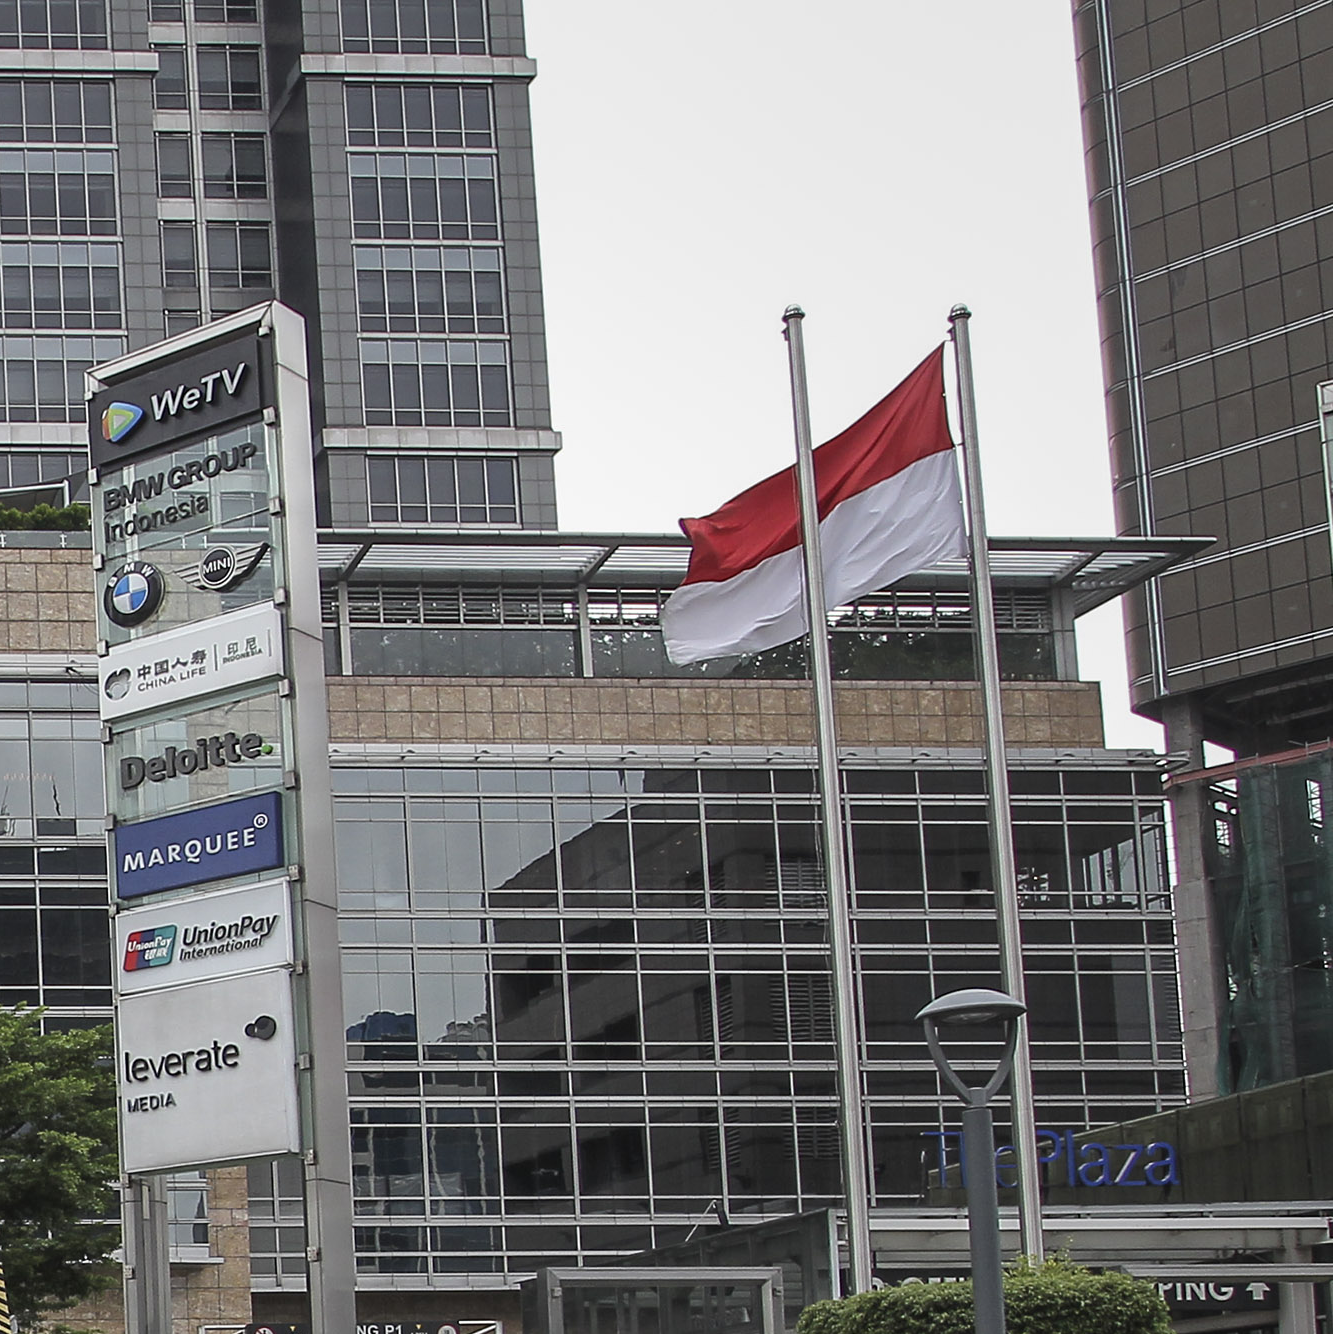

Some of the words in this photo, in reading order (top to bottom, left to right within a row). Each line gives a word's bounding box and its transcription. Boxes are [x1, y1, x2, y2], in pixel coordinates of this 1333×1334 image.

[150, 362, 247, 423] WeTV
[104, 472, 165, 512] BMW
[168, 442, 257, 491] GROUP
[104, 494, 210, 543] Indonesia
[203, 556, 232, 575] MINI
[222, 647, 263, 665] INDONESIA
[137, 675, 178, 693] CHINA
[180, 665, 207, 682] LIFE
[182, 912, 280, 947] UnionPay
[127, 935, 173, 953] UnionPay
[179, 935, 264, 962] International
[124, 1039, 240, 1084] leverate
[127, 1092, 177, 1114] MEDIA
